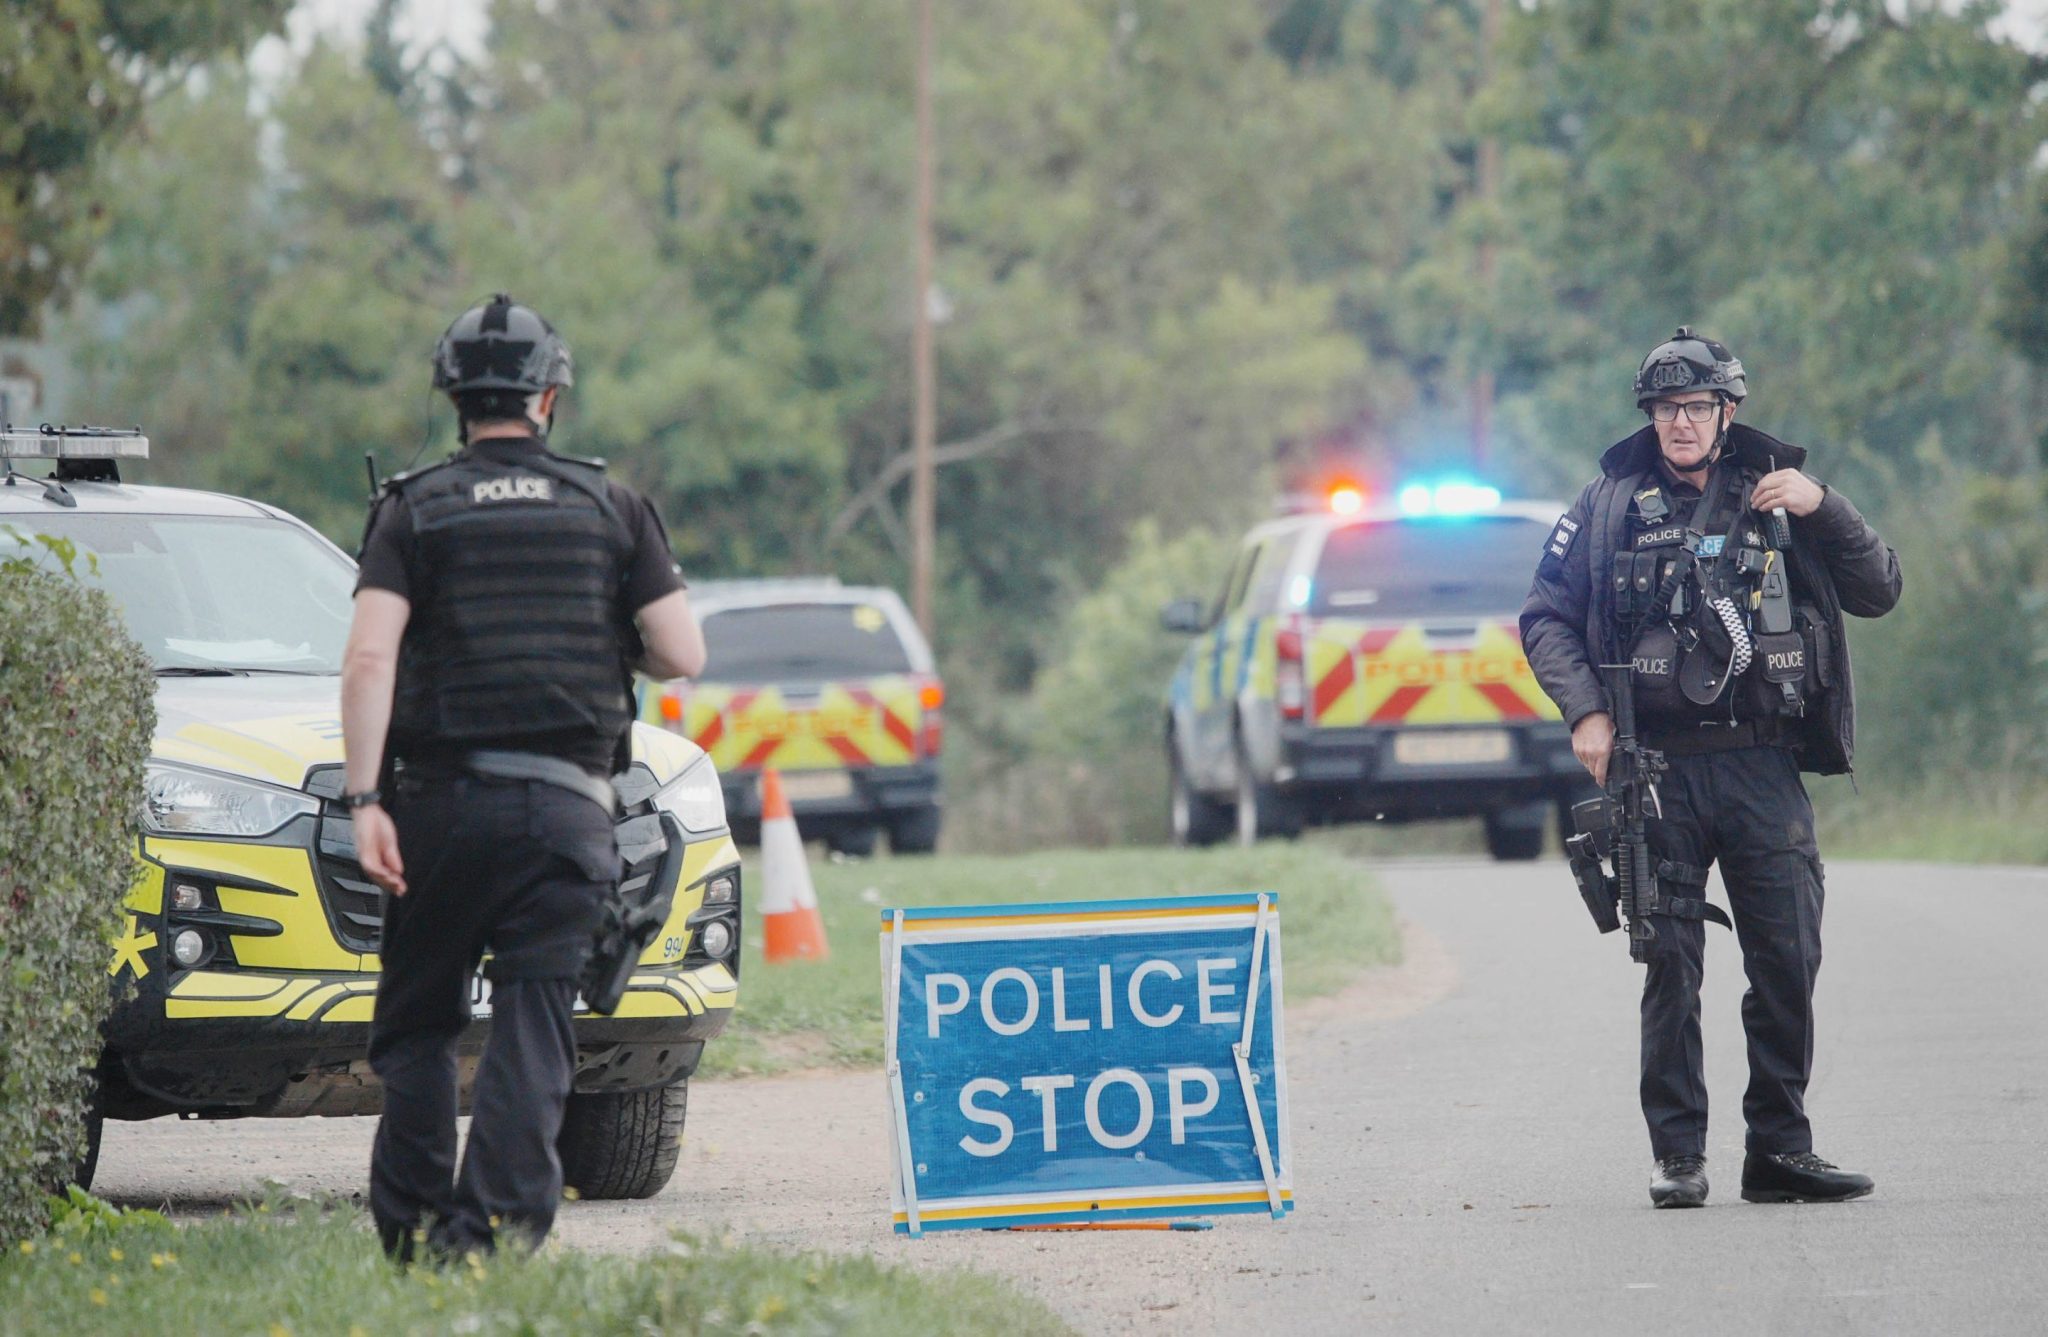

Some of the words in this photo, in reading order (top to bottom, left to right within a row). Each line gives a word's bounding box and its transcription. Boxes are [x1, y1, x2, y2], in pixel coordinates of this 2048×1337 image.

[473, 476, 552, 503] POLICE
[1559, 517, 1579, 532] POLICE
[1638, 529, 1681, 546] POLICE
[1632, 658, 1668, 674] POLICE
[1767, 651, 1803, 670] POLICE
[925, 958, 1241, 1038] POLICE
[958, 1067, 1220, 1157] STOP
